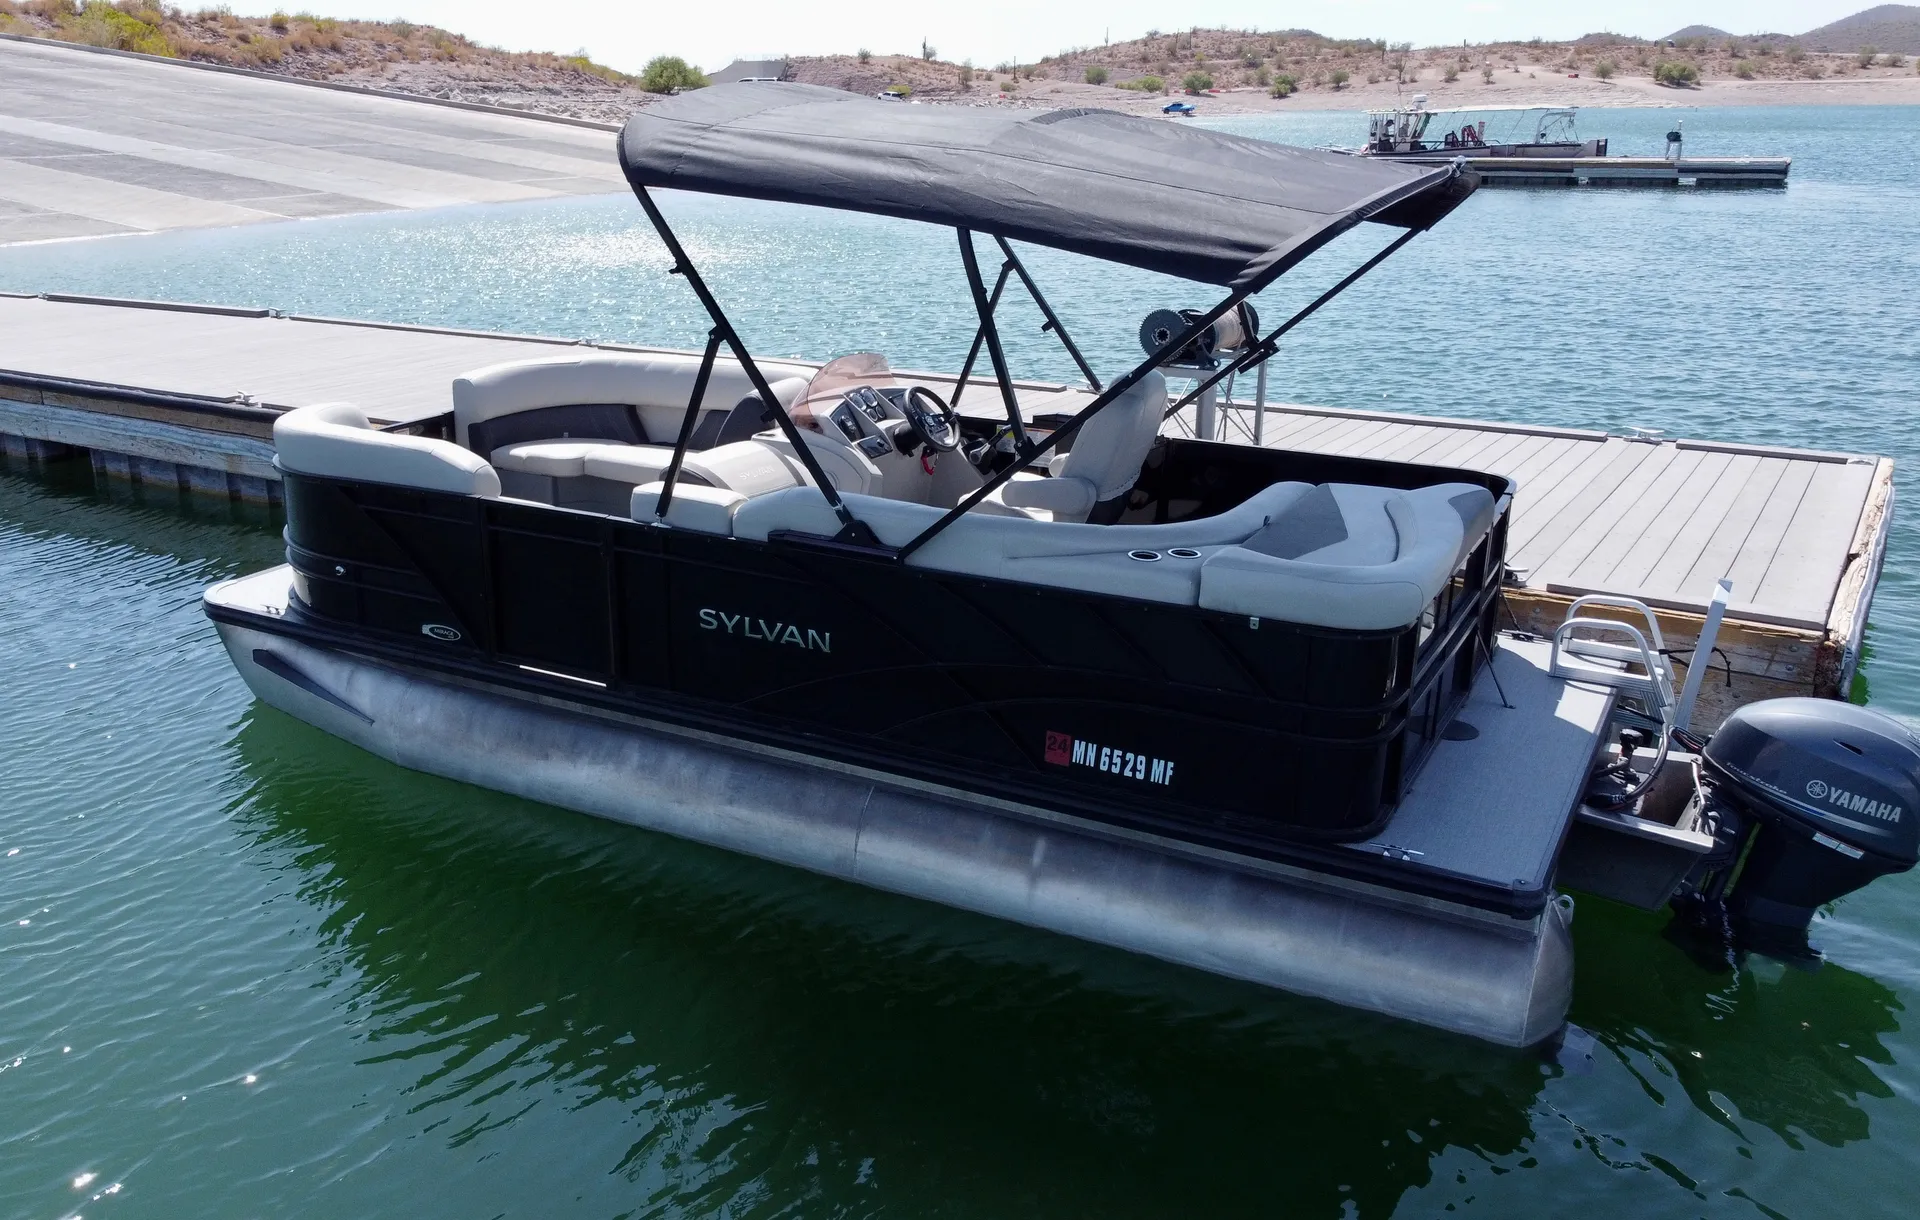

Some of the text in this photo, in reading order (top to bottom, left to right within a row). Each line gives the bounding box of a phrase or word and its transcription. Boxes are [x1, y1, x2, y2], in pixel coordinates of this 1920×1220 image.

[699, 608, 831, 653] SYLVAN
[1046, 735, 1069, 753] 24
[1072, 739, 1175, 786] MN 6529 MF
[1828, 787, 1902, 823] YAMAHA
